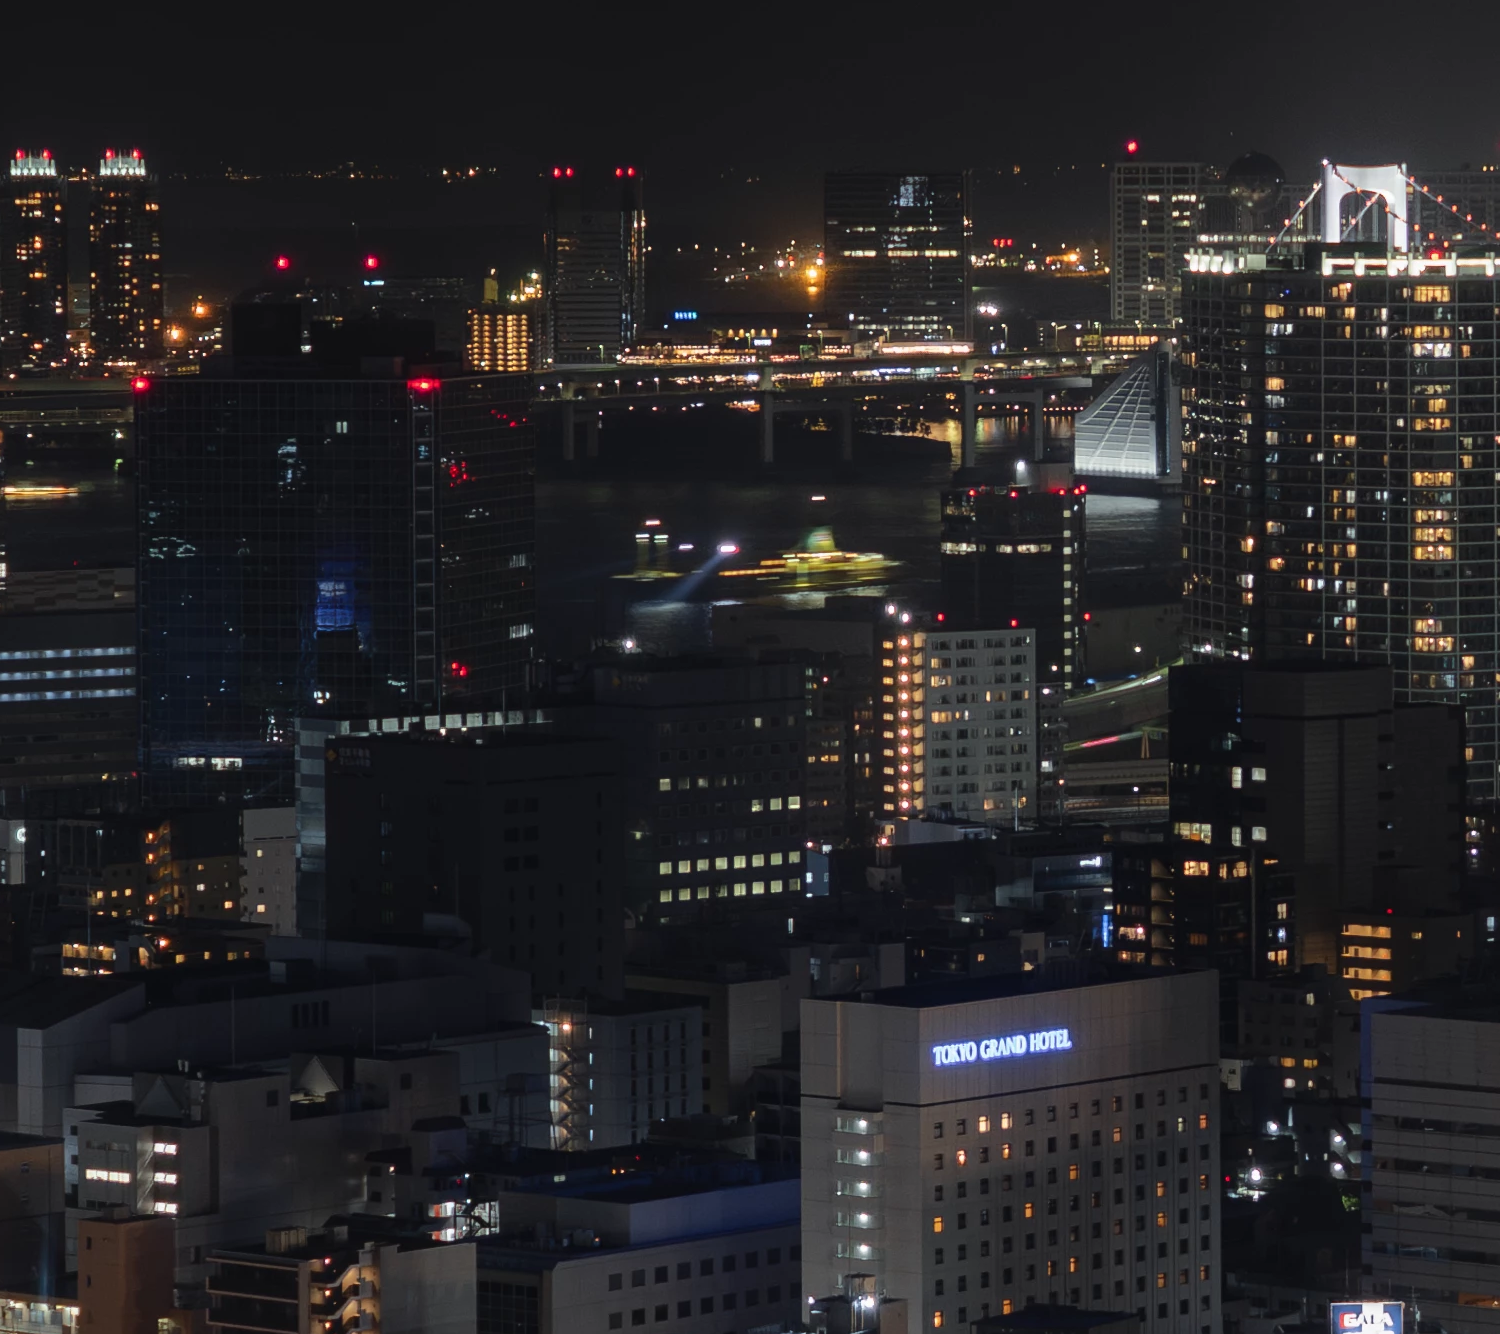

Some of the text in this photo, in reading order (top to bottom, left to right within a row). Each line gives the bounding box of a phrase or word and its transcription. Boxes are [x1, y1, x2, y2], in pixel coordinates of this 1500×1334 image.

[933, 1029, 1072, 1066] TOKYO GRAND HOTEL
[1340, 1312, 1394, 1329] GALA
